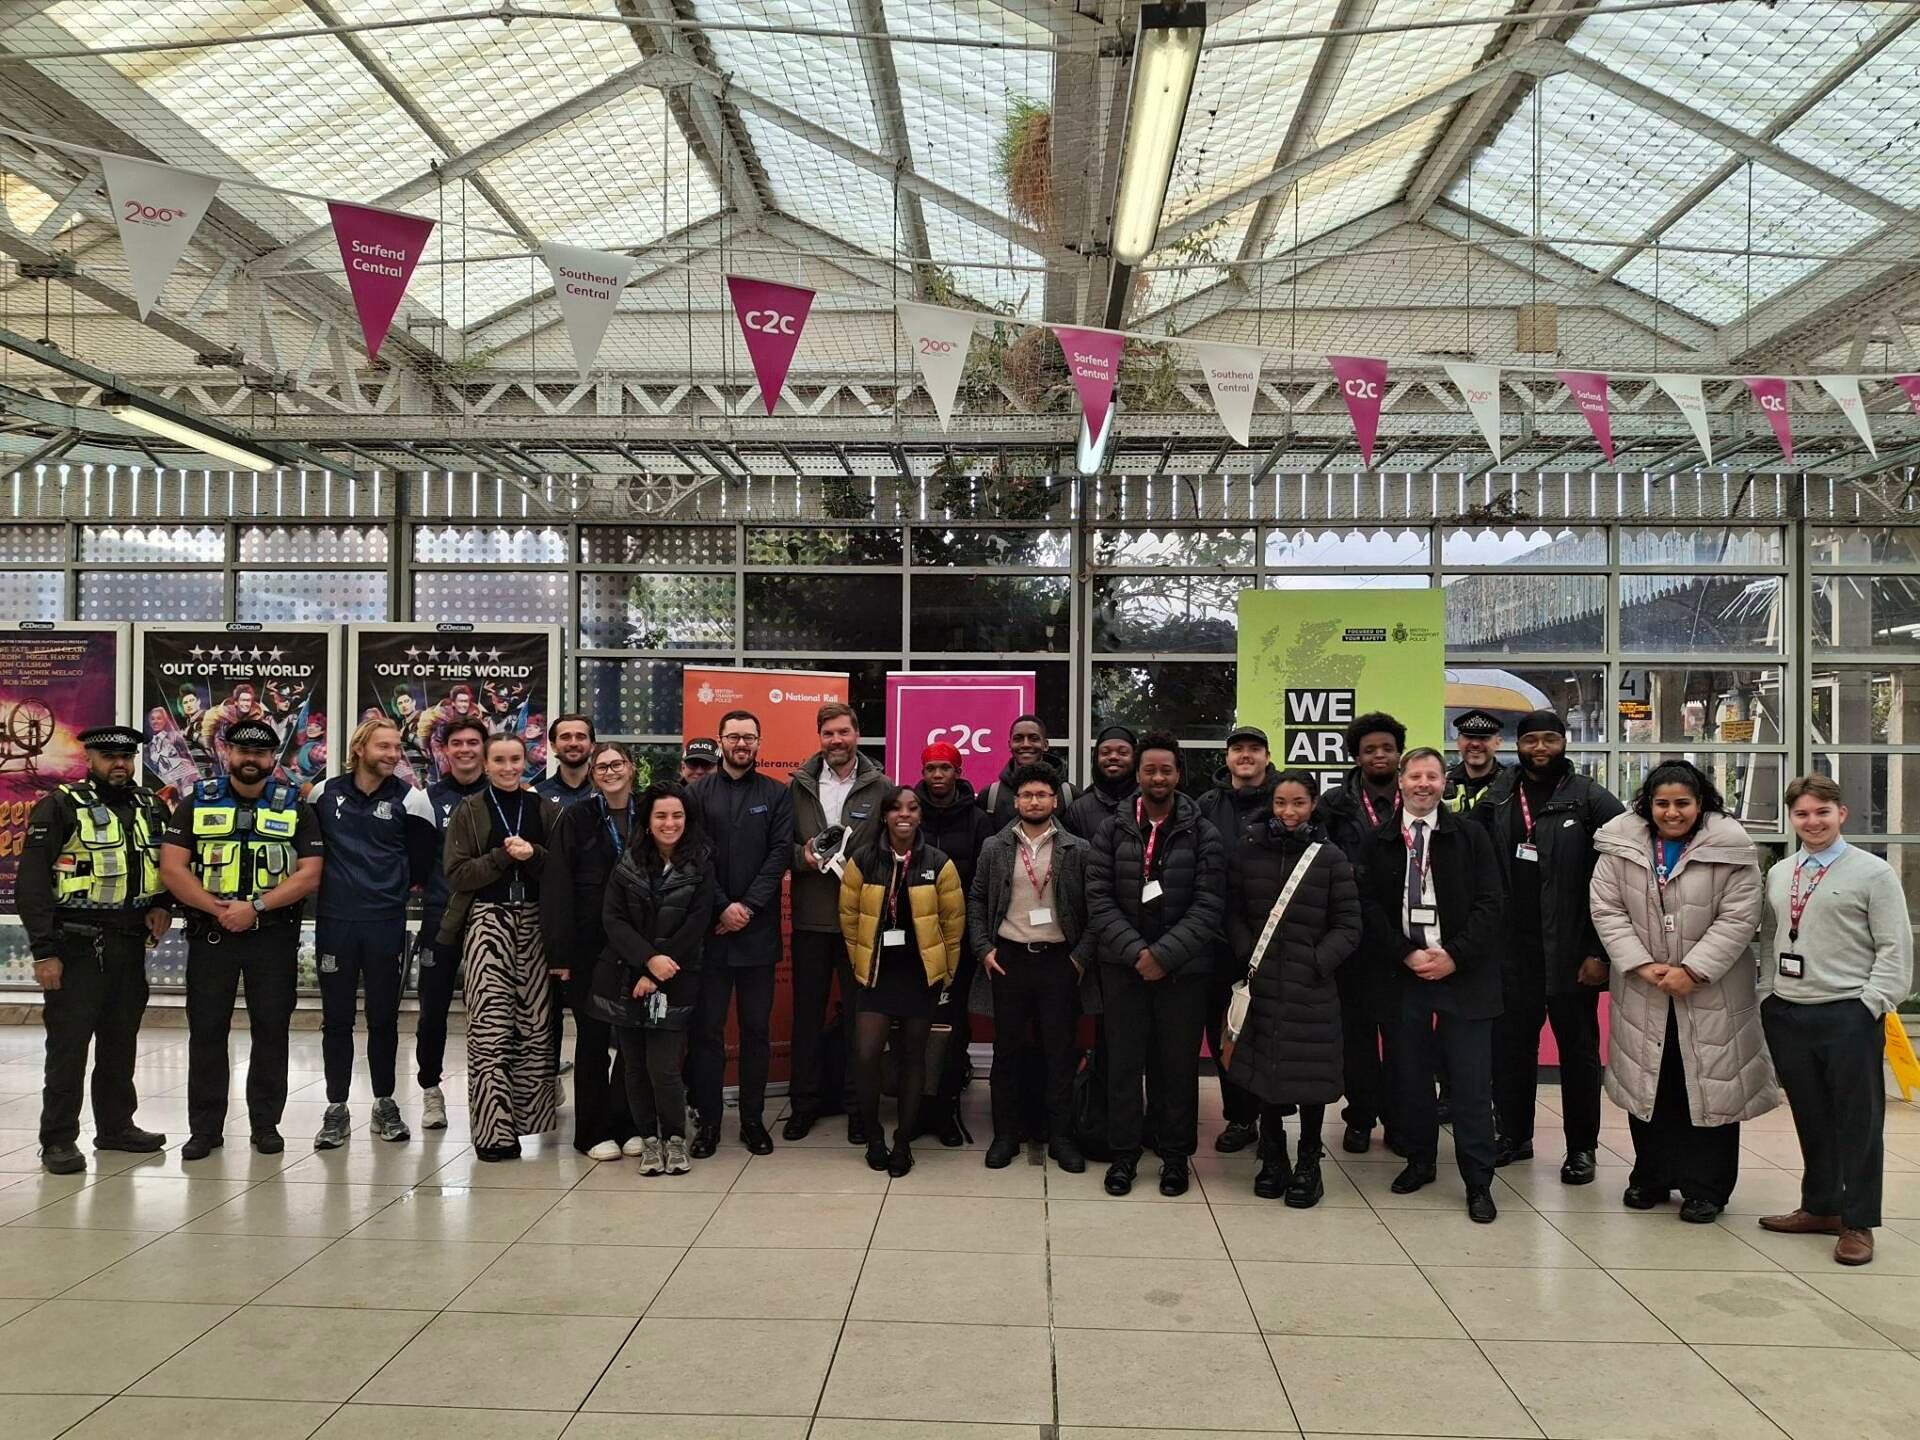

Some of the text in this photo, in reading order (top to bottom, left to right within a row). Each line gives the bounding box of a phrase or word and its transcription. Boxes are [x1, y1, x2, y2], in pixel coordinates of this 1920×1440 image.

[124, 200, 173, 223] 200
[352, 240, 406, 261] Sarfend
[352, 258, 403, 278] Central
[559, 266, 618, 286] Southend
[566, 283, 610, 300] Central
[1073, 352, 1109, 368] Sarfend
[1076, 366, 1109, 381] Central
[1211, 369, 1254, 380] Southend
[1217, 382, 1250, 393] Central
[227, 623, 261, 631] JCDecaux
[197, 663, 218, 676] OF
[220, 664, 254, 676] THIS
[413, 664, 435, 676] OF
[438, 665, 471, 677] THIS
[785, 692, 839, 703] National Rail
[1288, 692, 1353, 722] WE
[689, 742, 713, 751] POLICE
[1287, 732, 1356, 762] AR
[753, 759, 800, 768] olerance
